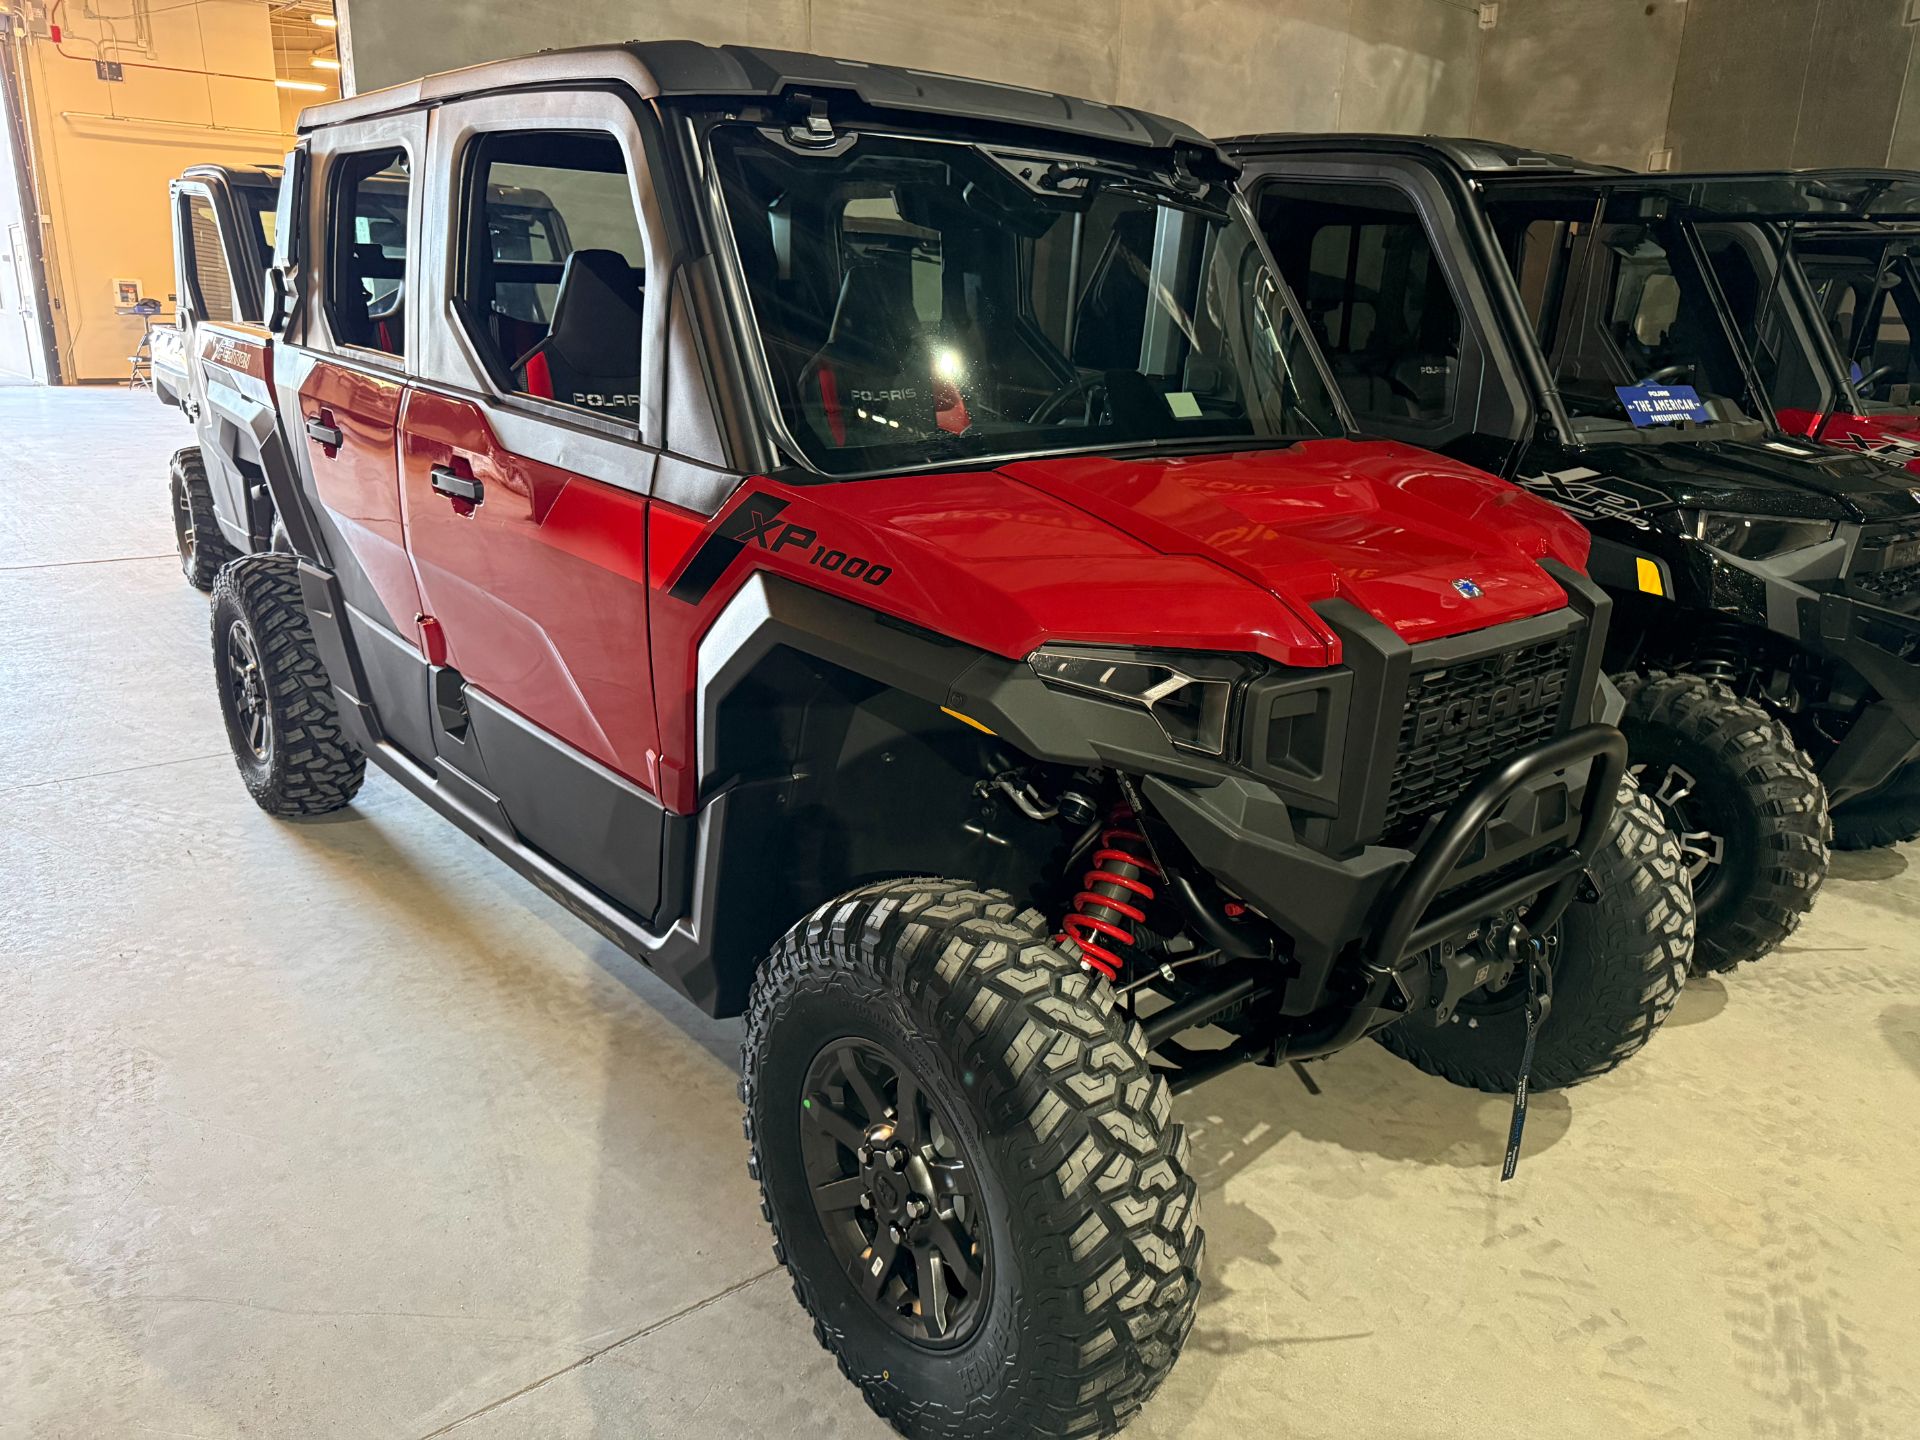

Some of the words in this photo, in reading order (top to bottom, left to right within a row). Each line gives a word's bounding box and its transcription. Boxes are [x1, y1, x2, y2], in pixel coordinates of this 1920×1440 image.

[850, 388, 917, 401] POLARIS
[1632, 400, 1654, 413] THE
[1653, 398, 1697, 412] AMERICAN
[1593, 505, 1650, 527] 1000
[735, 511, 818, 552] XP
[809, 545, 893, 586] 1000
[1414, 668, 1569, 746] POLARIS
